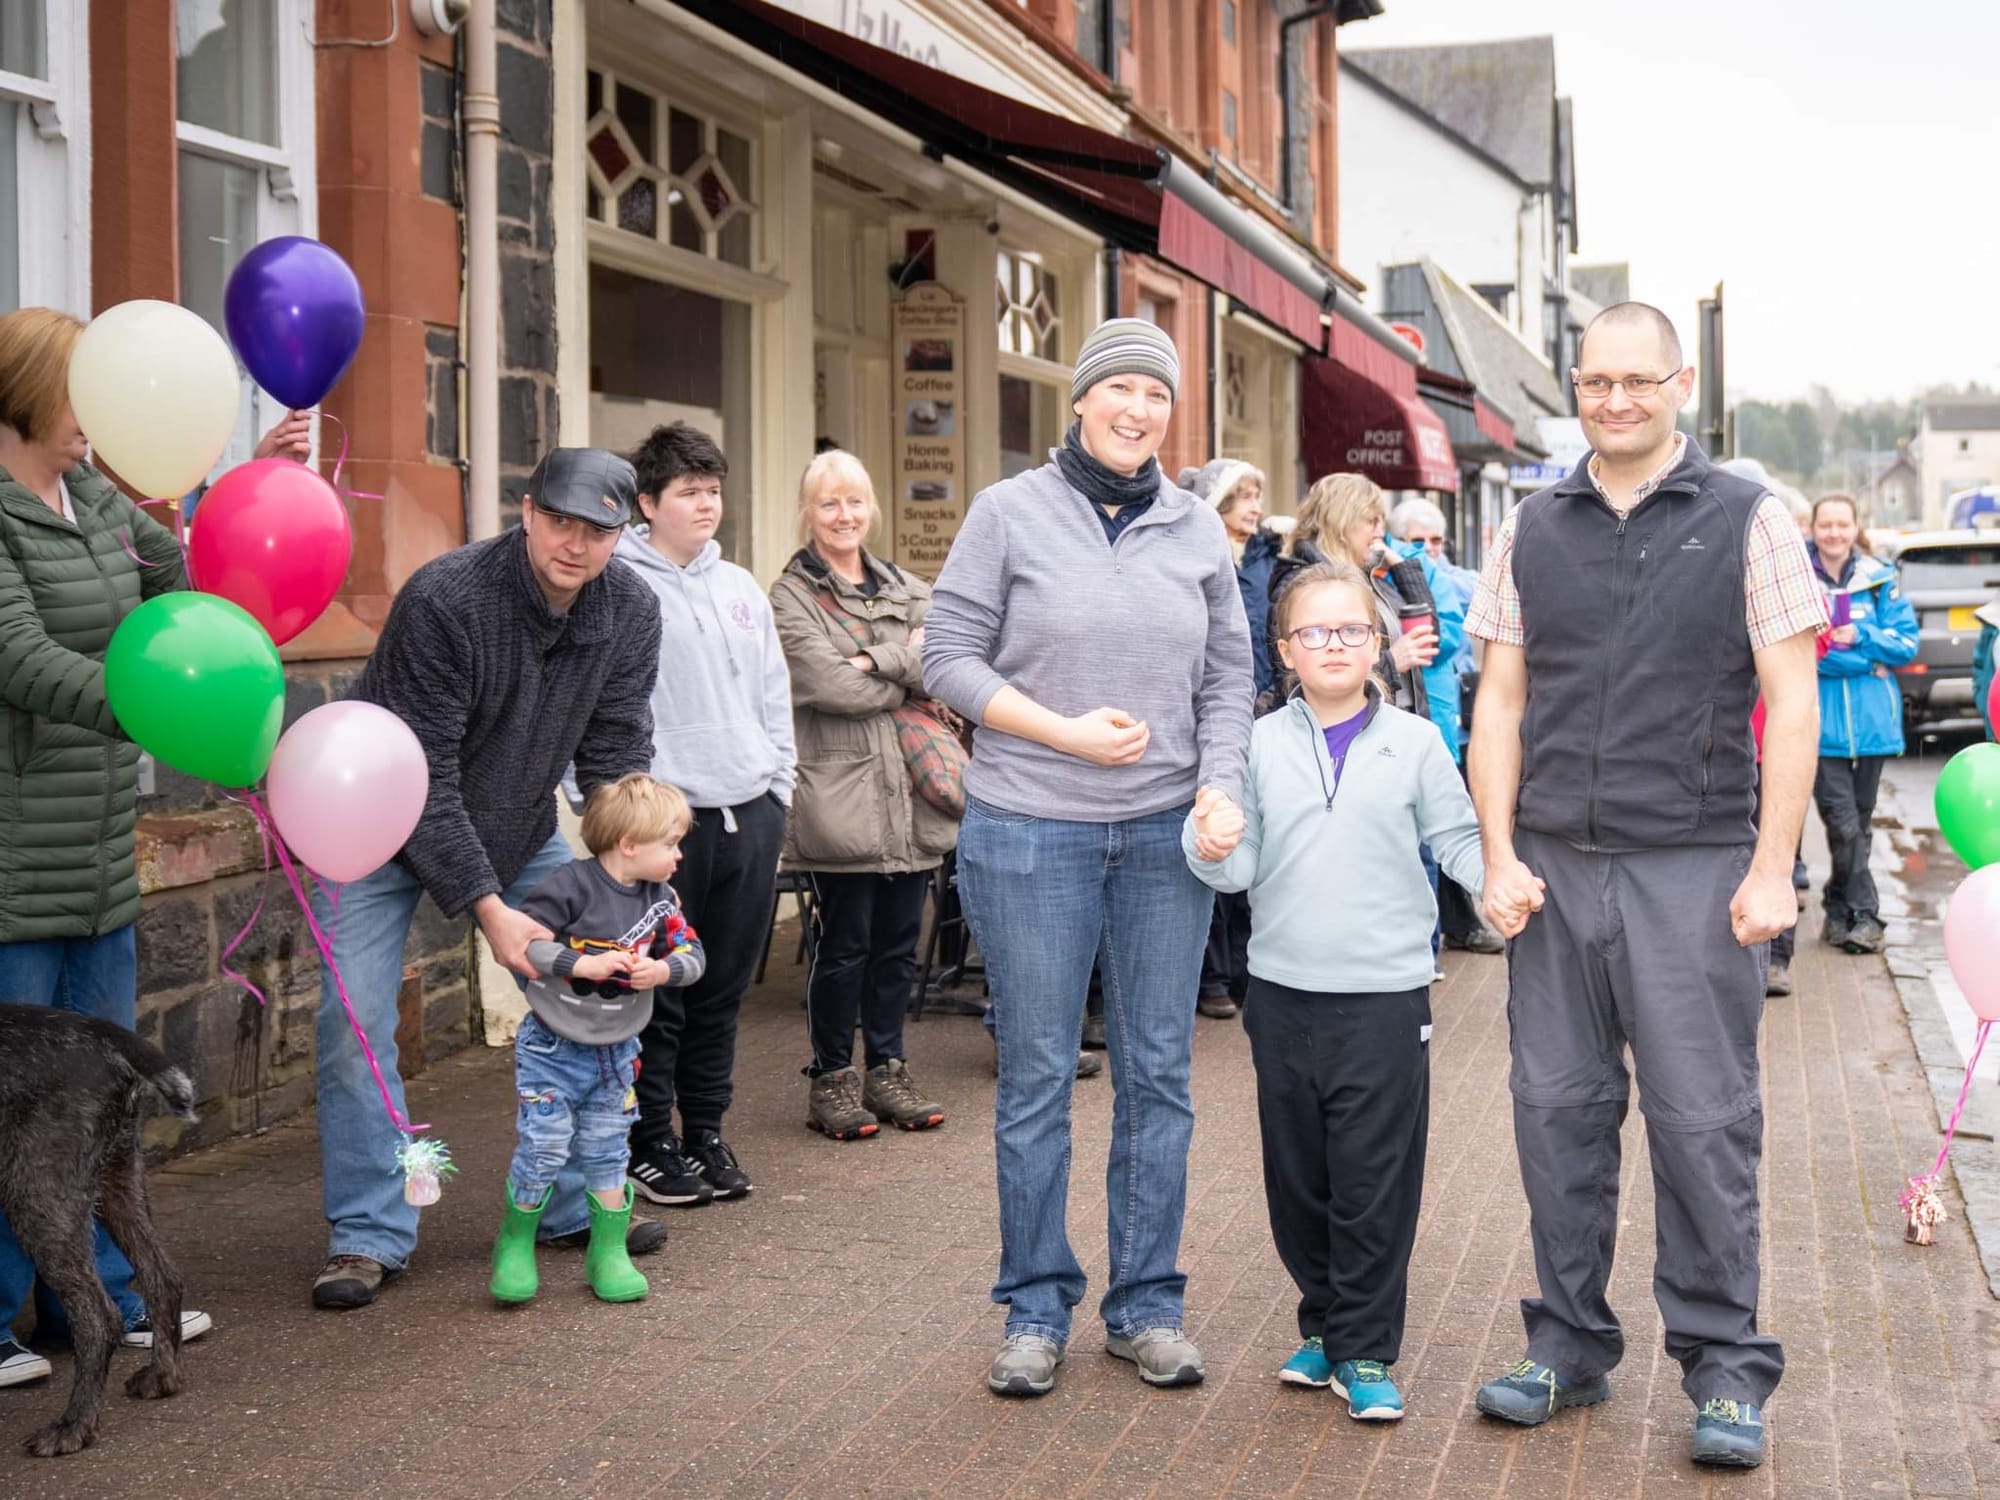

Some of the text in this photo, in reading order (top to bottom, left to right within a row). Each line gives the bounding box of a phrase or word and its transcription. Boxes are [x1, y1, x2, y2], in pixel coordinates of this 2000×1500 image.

[904, 377, 953, 391] Coffee
[1364, 429, 1403, 446] POST
[907, 444, 950, 456] Home
[1346, 448, 1403, 465] OFFICE
[904, 459, 953, 474] Baking
[904, 507, 956, 520] Snacks
[923, 522, 937, 533] to
[909, 533, 953, 547] Cours
